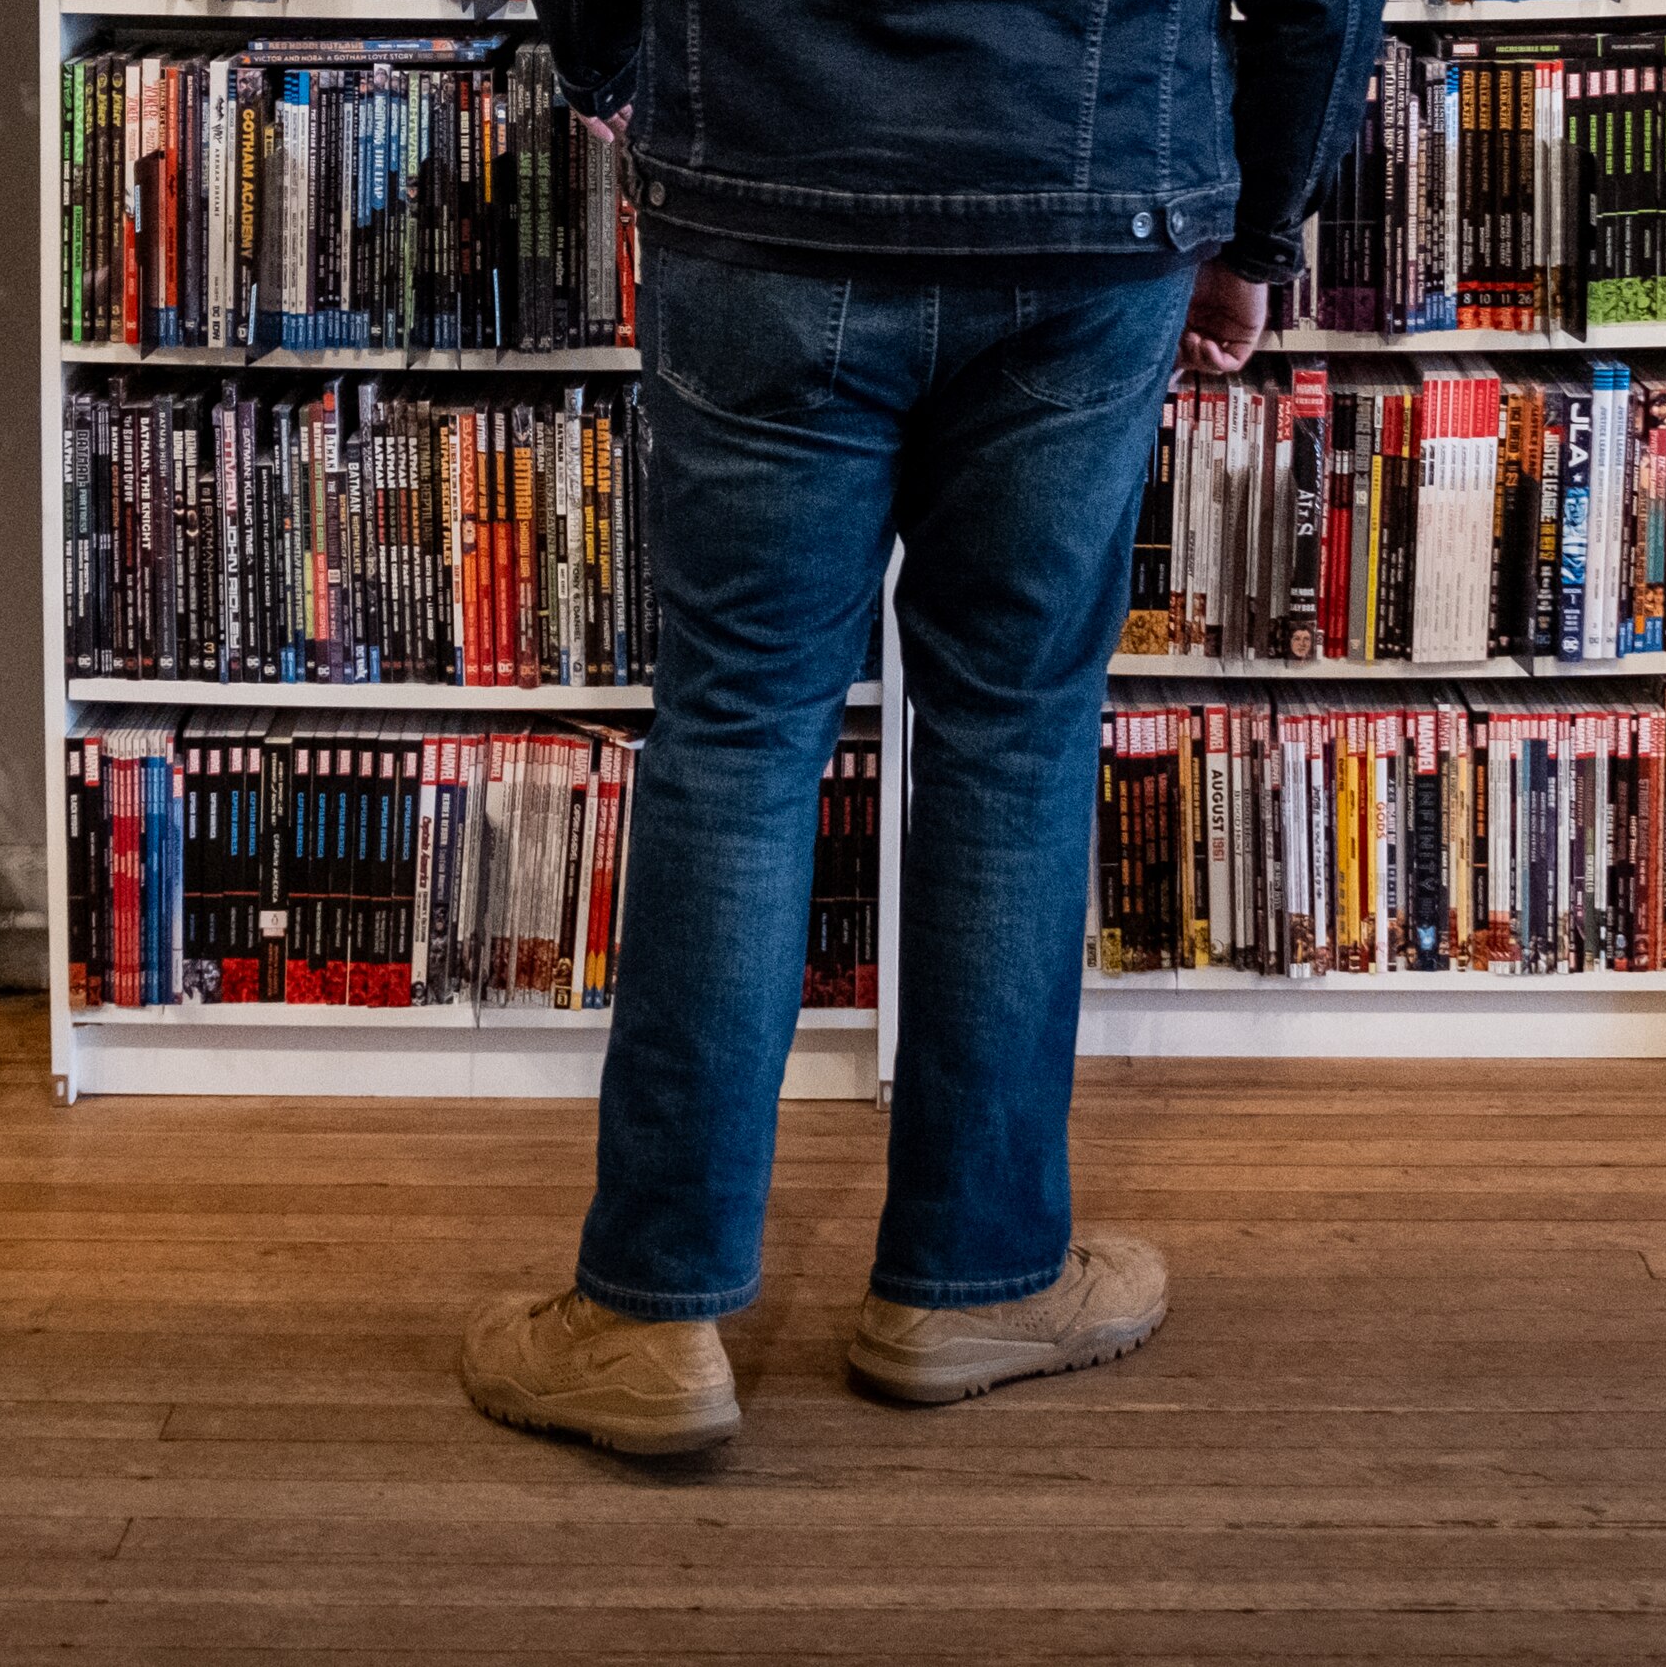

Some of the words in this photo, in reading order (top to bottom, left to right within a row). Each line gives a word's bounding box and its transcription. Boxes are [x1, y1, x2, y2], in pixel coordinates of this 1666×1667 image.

[239, 107, 255, 182] GOTHAM
[239, 187, 254, 261] ACADEMY
[1569, 402, 1589, 468] JLA
[1211, 769, 1224, 832] AUGUST
